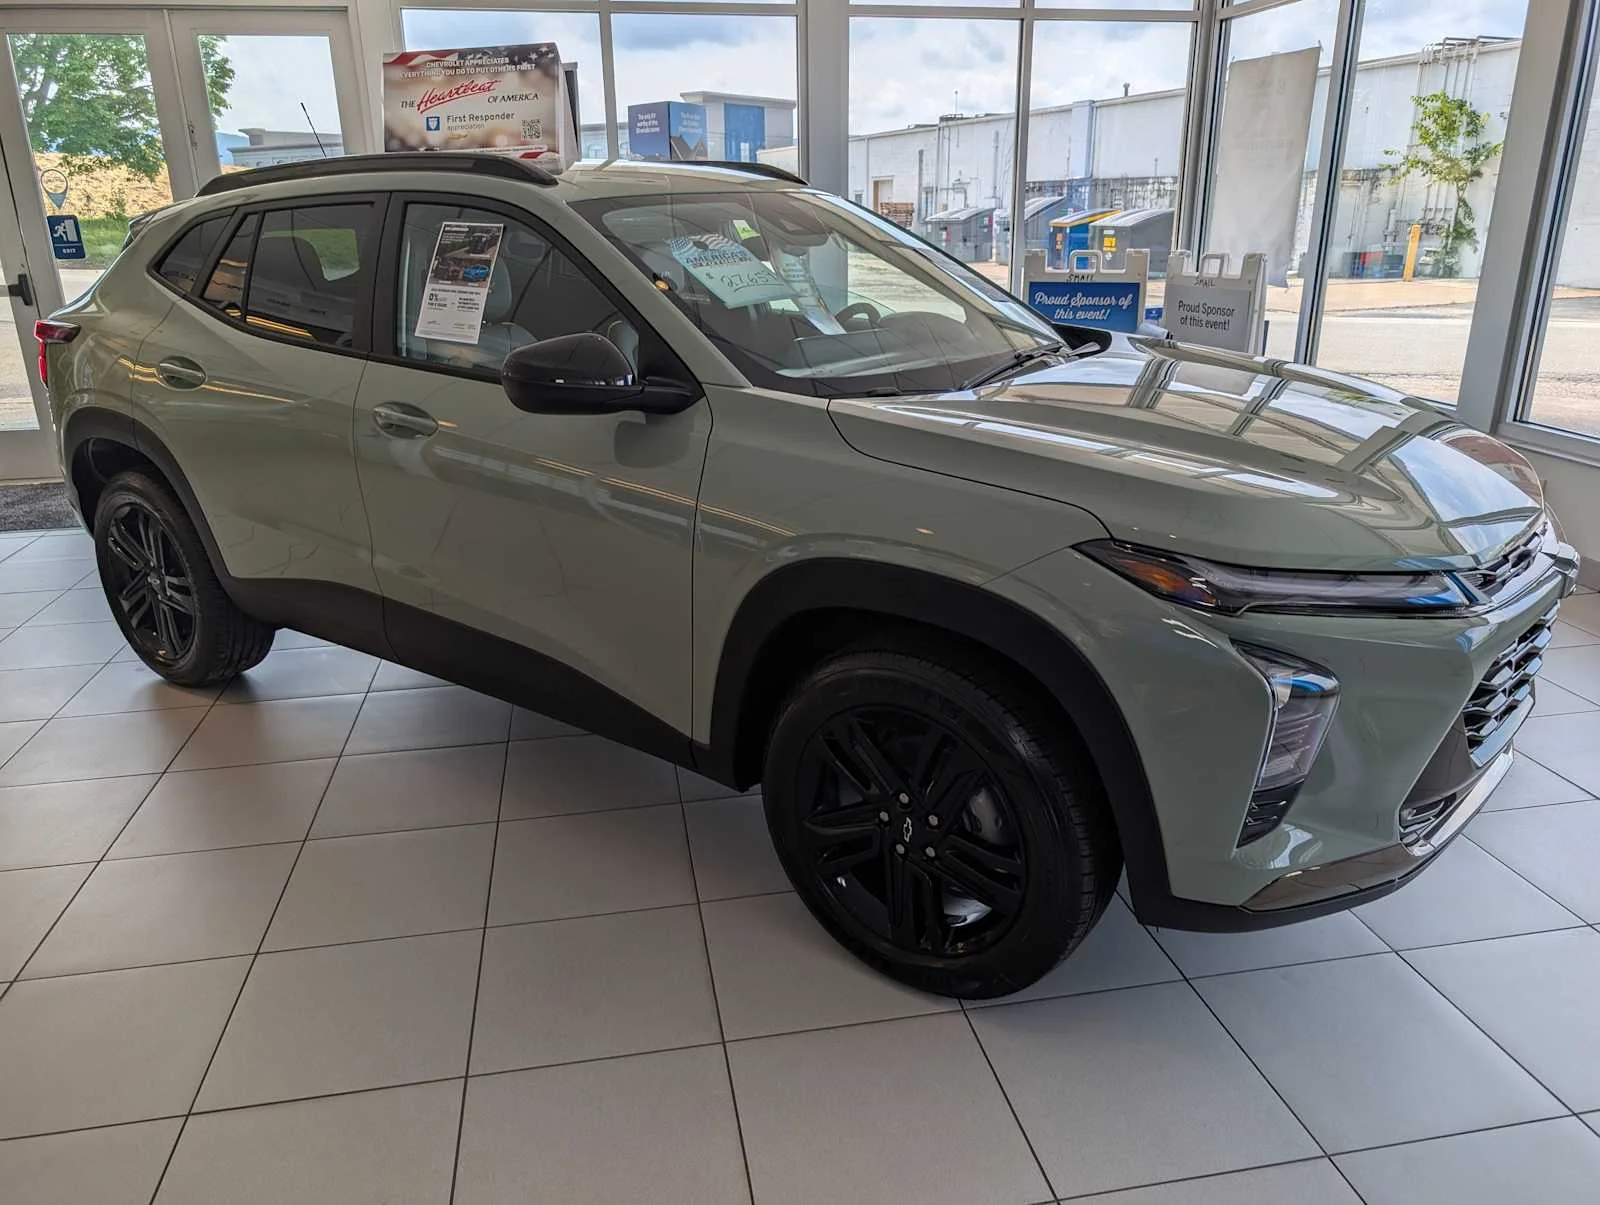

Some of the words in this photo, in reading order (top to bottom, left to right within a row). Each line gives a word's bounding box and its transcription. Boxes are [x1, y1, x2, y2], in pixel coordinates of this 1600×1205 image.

[426, 60, 464, 69] CHEVROLET
[465, 57, 509, 66] APPRECIATES
[442, 68, 456, 76] YOU
[490, 64, 516, 73] OTHERS
[516, 63, 536, 71] FIRST
[400, 100, 416, 109] THE
[416, 79, 502, 113] Heartbeat
[487, 95, 498, 104] OF
[499, 92, 539, 103] AMERICA
[446, 115, 467, 124] First
[468, 112, 515, 123] Responder
[1034, 292, 1070, 306] Proud
[1071, 292, 1119, 308] Sponsor
[1118, 294, 1134, 309] of
[1054, 308, 1074, 319] this
[1076, 308, 1111, 320] event!
[1178, 300, 1200, 313] Proud
[1202, 303, 1235, 318] Sponsor
[1180, 315, 1188, 325] of
[1189, 316, 1204, 327] this
[1205, 319, 1230, 331] event!
